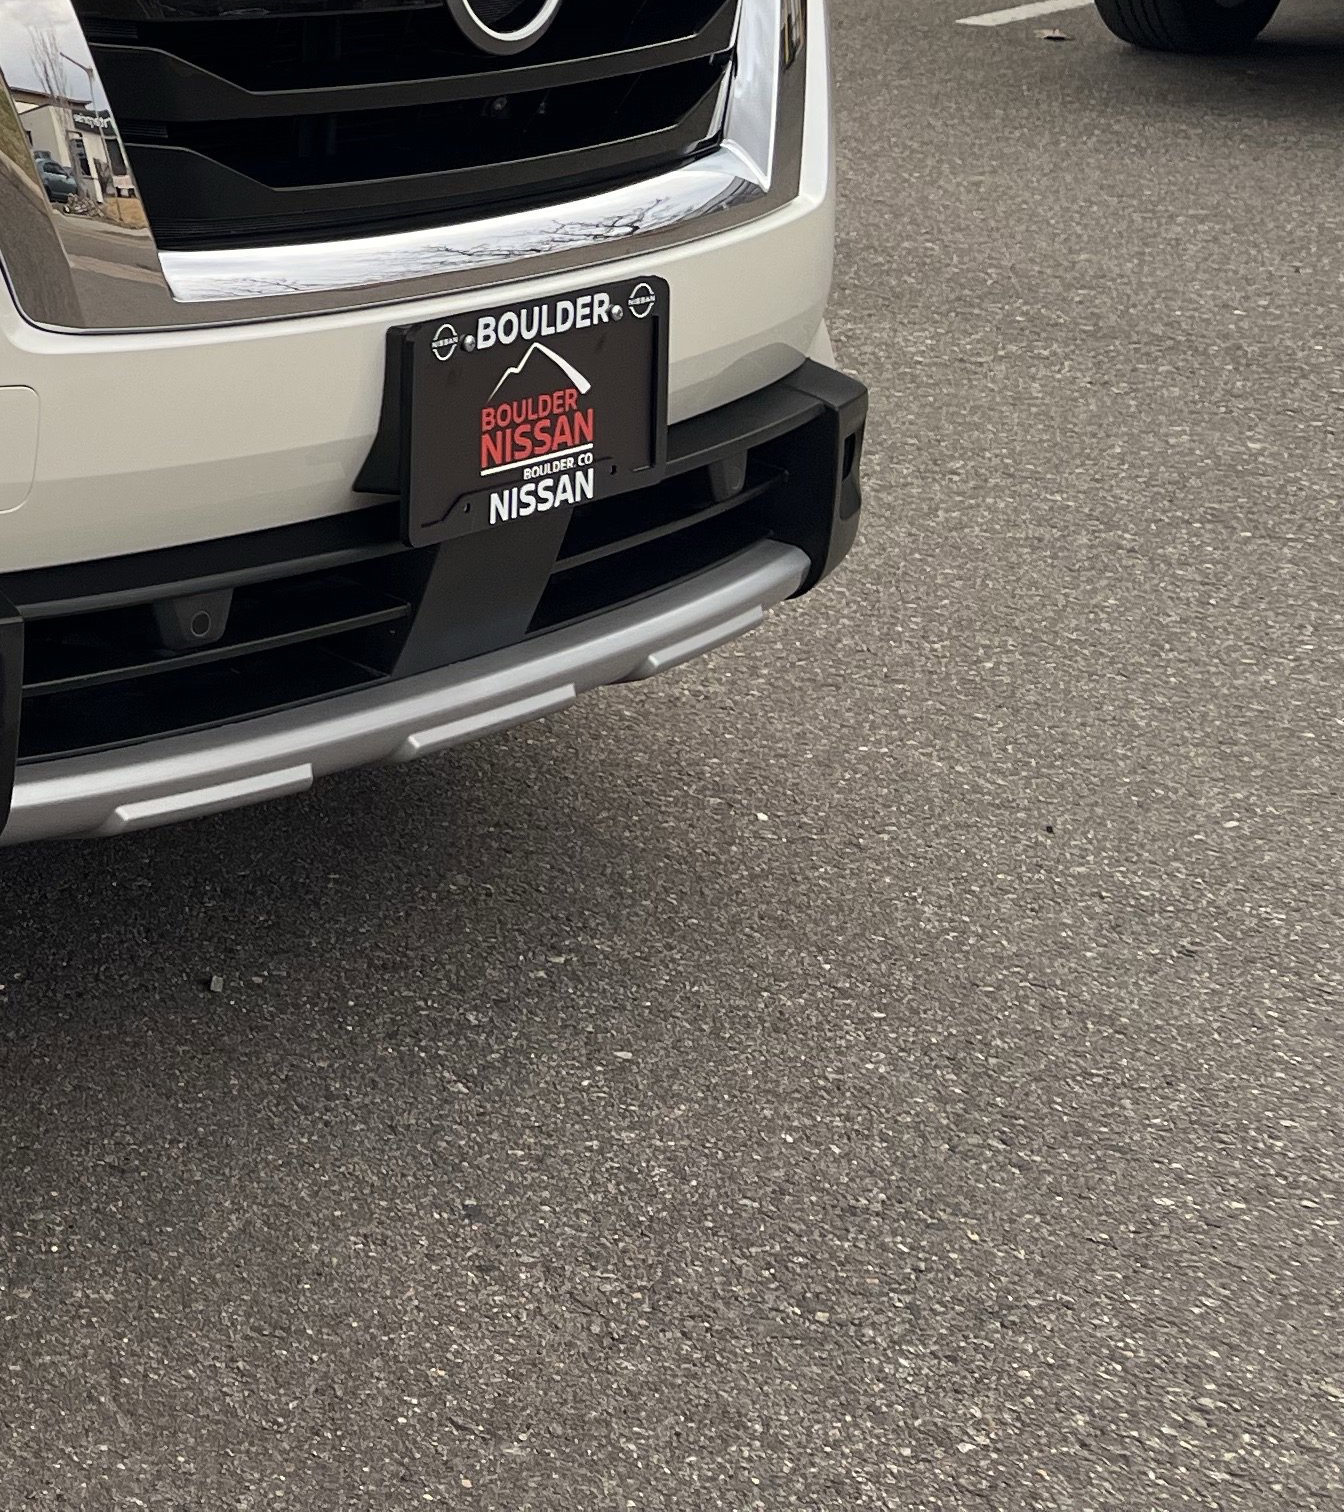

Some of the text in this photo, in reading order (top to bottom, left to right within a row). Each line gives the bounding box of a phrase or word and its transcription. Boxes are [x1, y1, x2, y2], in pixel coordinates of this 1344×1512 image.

[475, 292, 612, 350] BOULDER
[480, 407, 594, 469] NISSAN
[481, 387, 578, 431] BOULDER
[577, 452, 594, 468] CO
[489, 467, 595, 525] NISSAN
